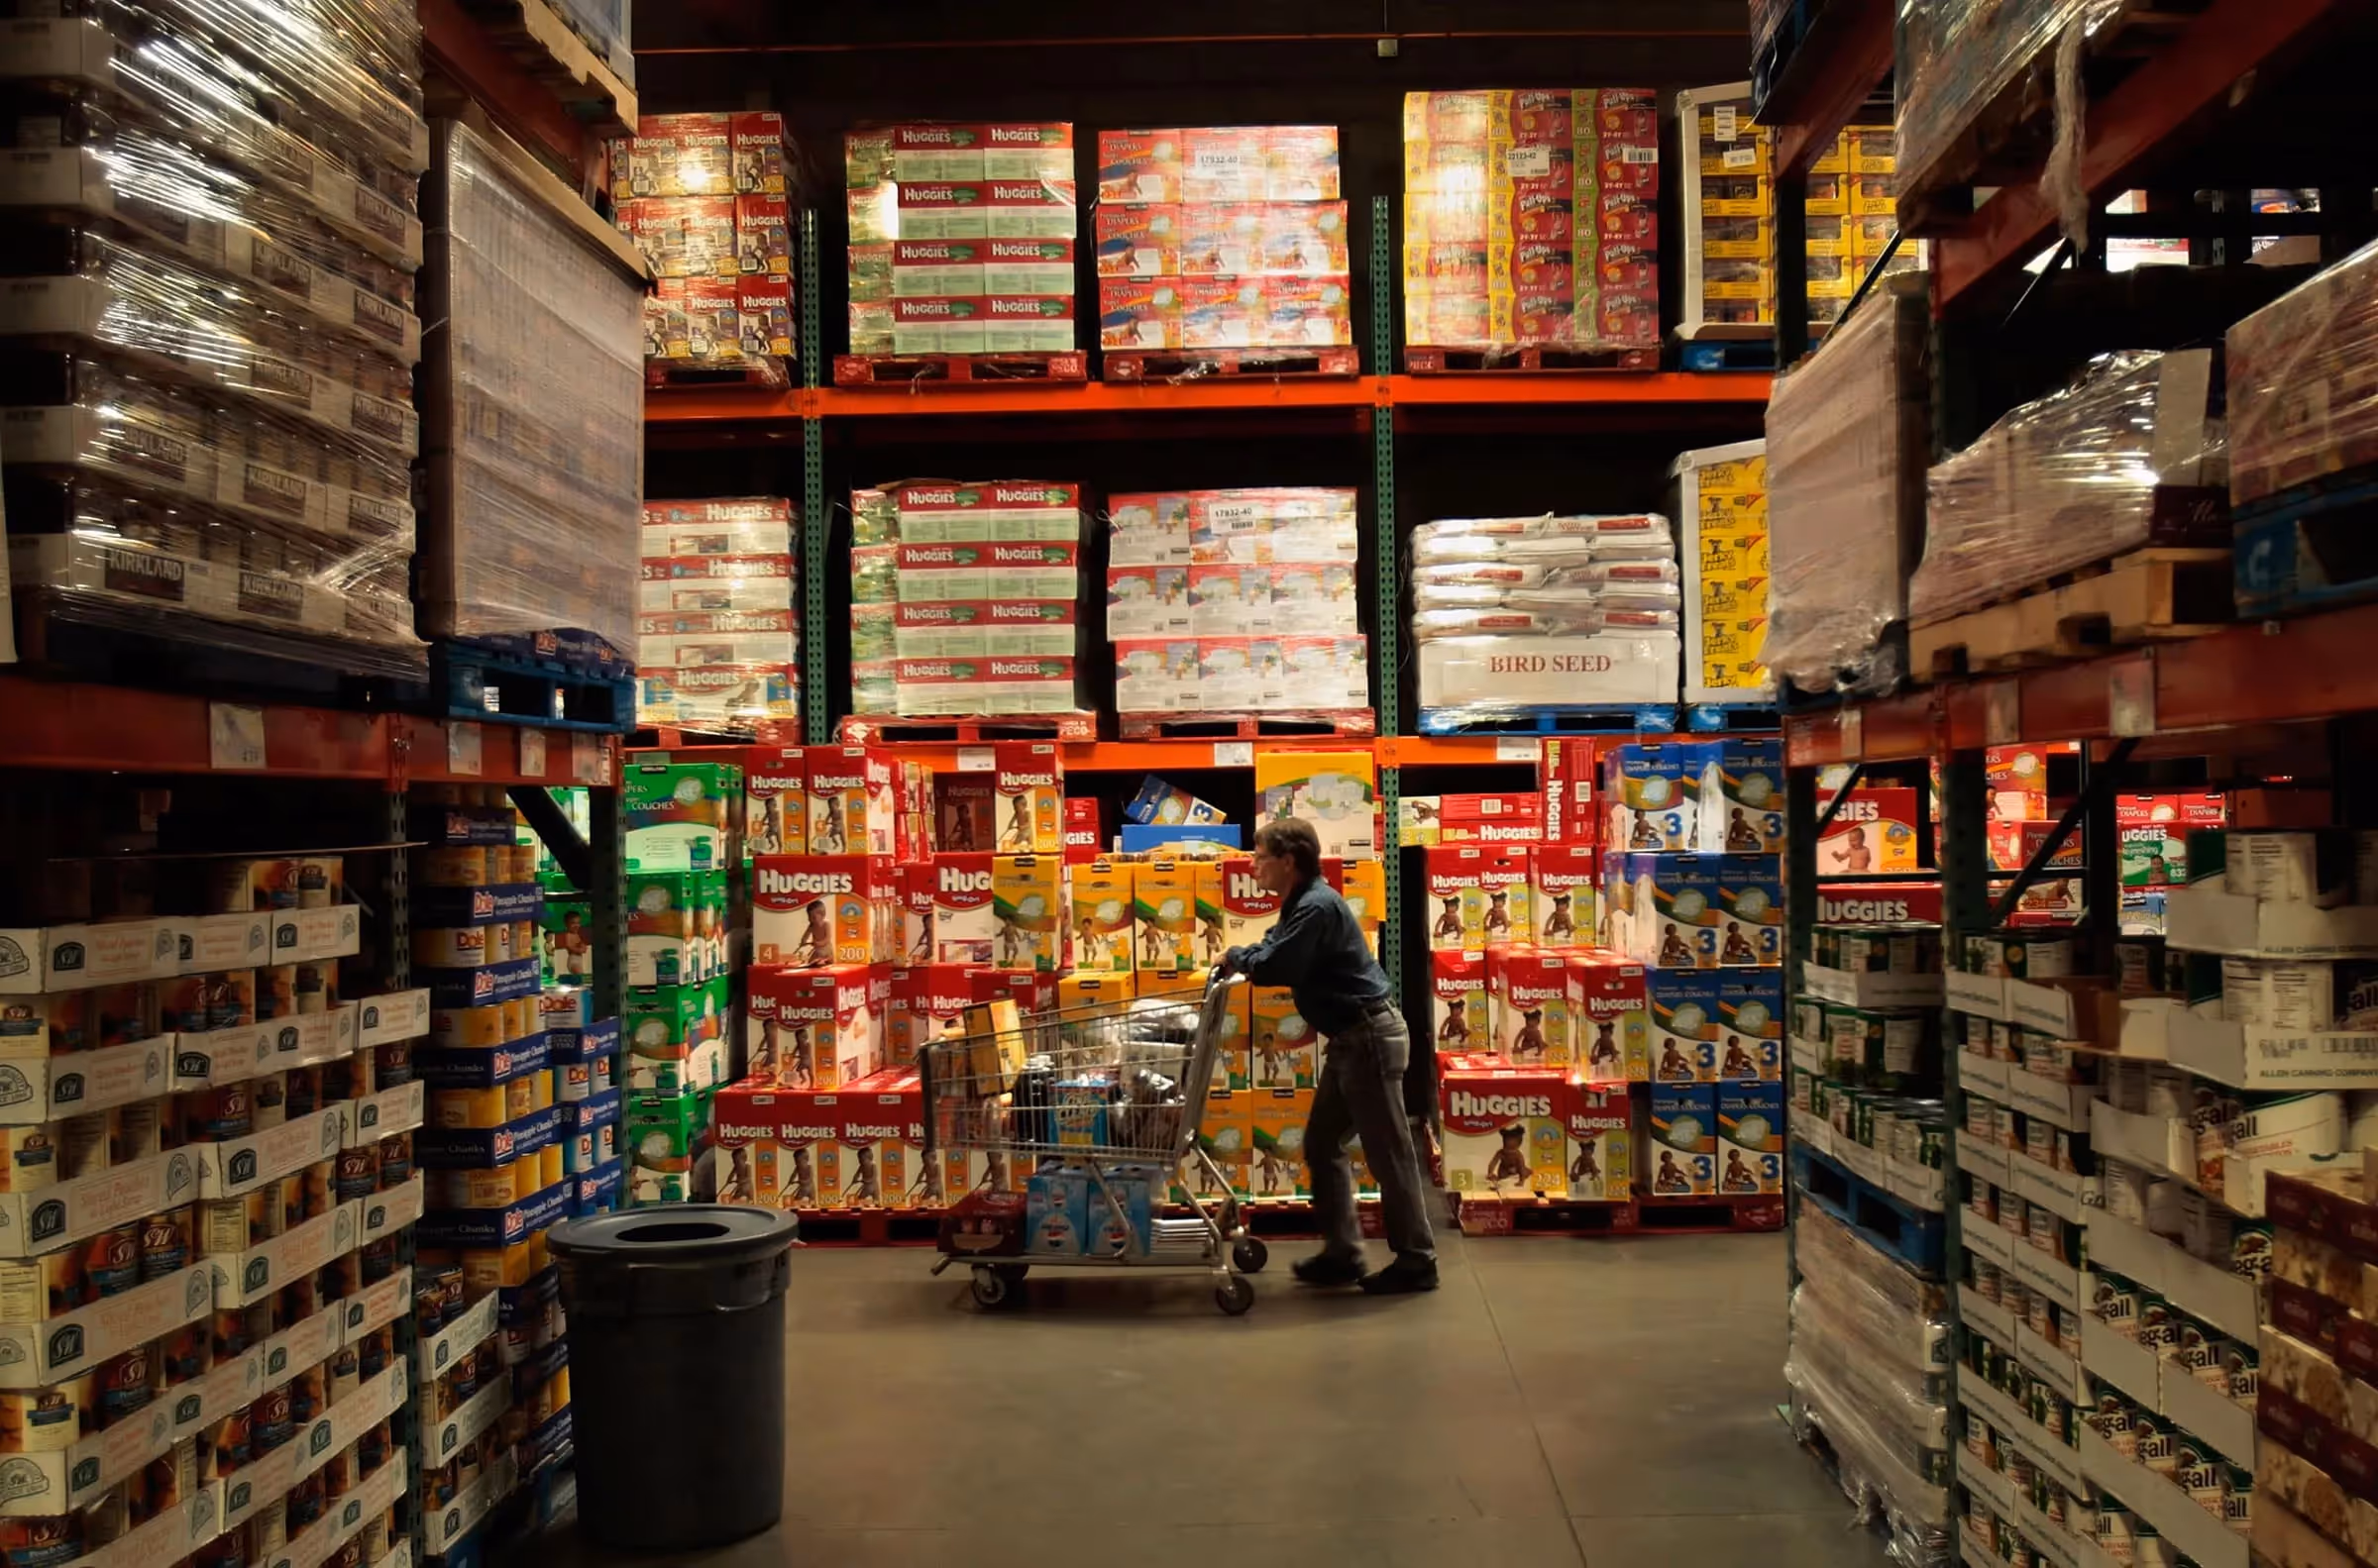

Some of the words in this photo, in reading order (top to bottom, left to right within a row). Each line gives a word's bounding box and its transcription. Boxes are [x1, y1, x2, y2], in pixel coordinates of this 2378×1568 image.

[737, 134, 780, 145] HUGGIES
[903, 130, 950, 143] HUGGIES
[992, 129, 1039, 142] HUGGIES
[905, 187, 953, 201] HUGGIES
[994, 186, 1042, 199] HUGGIES
[741, 216, 785, 226] HUGGIES
[902, 246, 949, 259] HUGGIES
[993, 244, 1040, 256] HUGGIES
[692, 298, 735, 308] HUGGIES
[743, 296, 786, 307] HUGGIES
[902, 302, 950, 315] HUGGIES
[993, 300, 1040, 313] HUGGIES
[909, 491, 955, 504] HUGGIES
[997, 488, 1045, 502] HUGGIES
[906, 550, 953, 563] HUGGIES
[995, 547, 1042, 561] HUGGIES
[109, 549, 182, 581] KIRKLAND
[904, 607, 951, 619] HUGGIES
[993, 605, 1040, 617] HUGGIES
[904, 665, 951, 677] HUGGIES
[992, 662, 1039, 675] HUGGIES
[1490, 655, 1546, 673] BIRD
[1553, 655, 1611, 672] SEED
[752, 775, 802, 788] HUGGIES
[813, 775, 864, 787] HUGGIES
[1000, 772, 1053, 785] HUGGIES
[632, 801, 675, 810] COUCHES
[1548, 780, 1564, 840] HUGGIES
[1665, 812, 1682, 836] 3
[1763, 813, 1783, 838] 3
[1479, 825, 1543, 841] HUGGIES
[696, 836, 712, 859] 5
[759, 869, 852, 893] HUGGIES
[1433, 875, 1479, 888] HUGGIES
[1481, 871, 1526, 884] HUGGIES
[1543, 873, 1590, 886] HUGGIES
[457, 931, 485, 947] Dole
[1696, 928, 1716, 954] 3
[1759, 927, 1779, 953] 3
[764, 946, 773, 960] 4
[840, 947, 865, 961] 200
[1438, 978, 1484, 991] HUGGIES
[1513, 986, 1564, 1000] HUGGIES
[544, 995, 578, 1010] Dole
[1589, 996, 1644, 1011] HUGGIES
[781, 1005, 834, 1019] HUGGIES
[1695, 1042, 1715, 1069] 3
[1759, 1041, 1779, 1068] 3
[1451, 1091, 1551, 1116] HUGGIES
[845, 1121, 901, 1137] HUGGIES
[1571, 1115, 1626, 1129] HUGGIES
[719, 1122, 774, 1138] HUGGIES
[782, 1123, 836, 1138] HUGGIES
[1692, 1155, 1712, 1181] 3
[1760, 1154, 1780, 1180] 3
